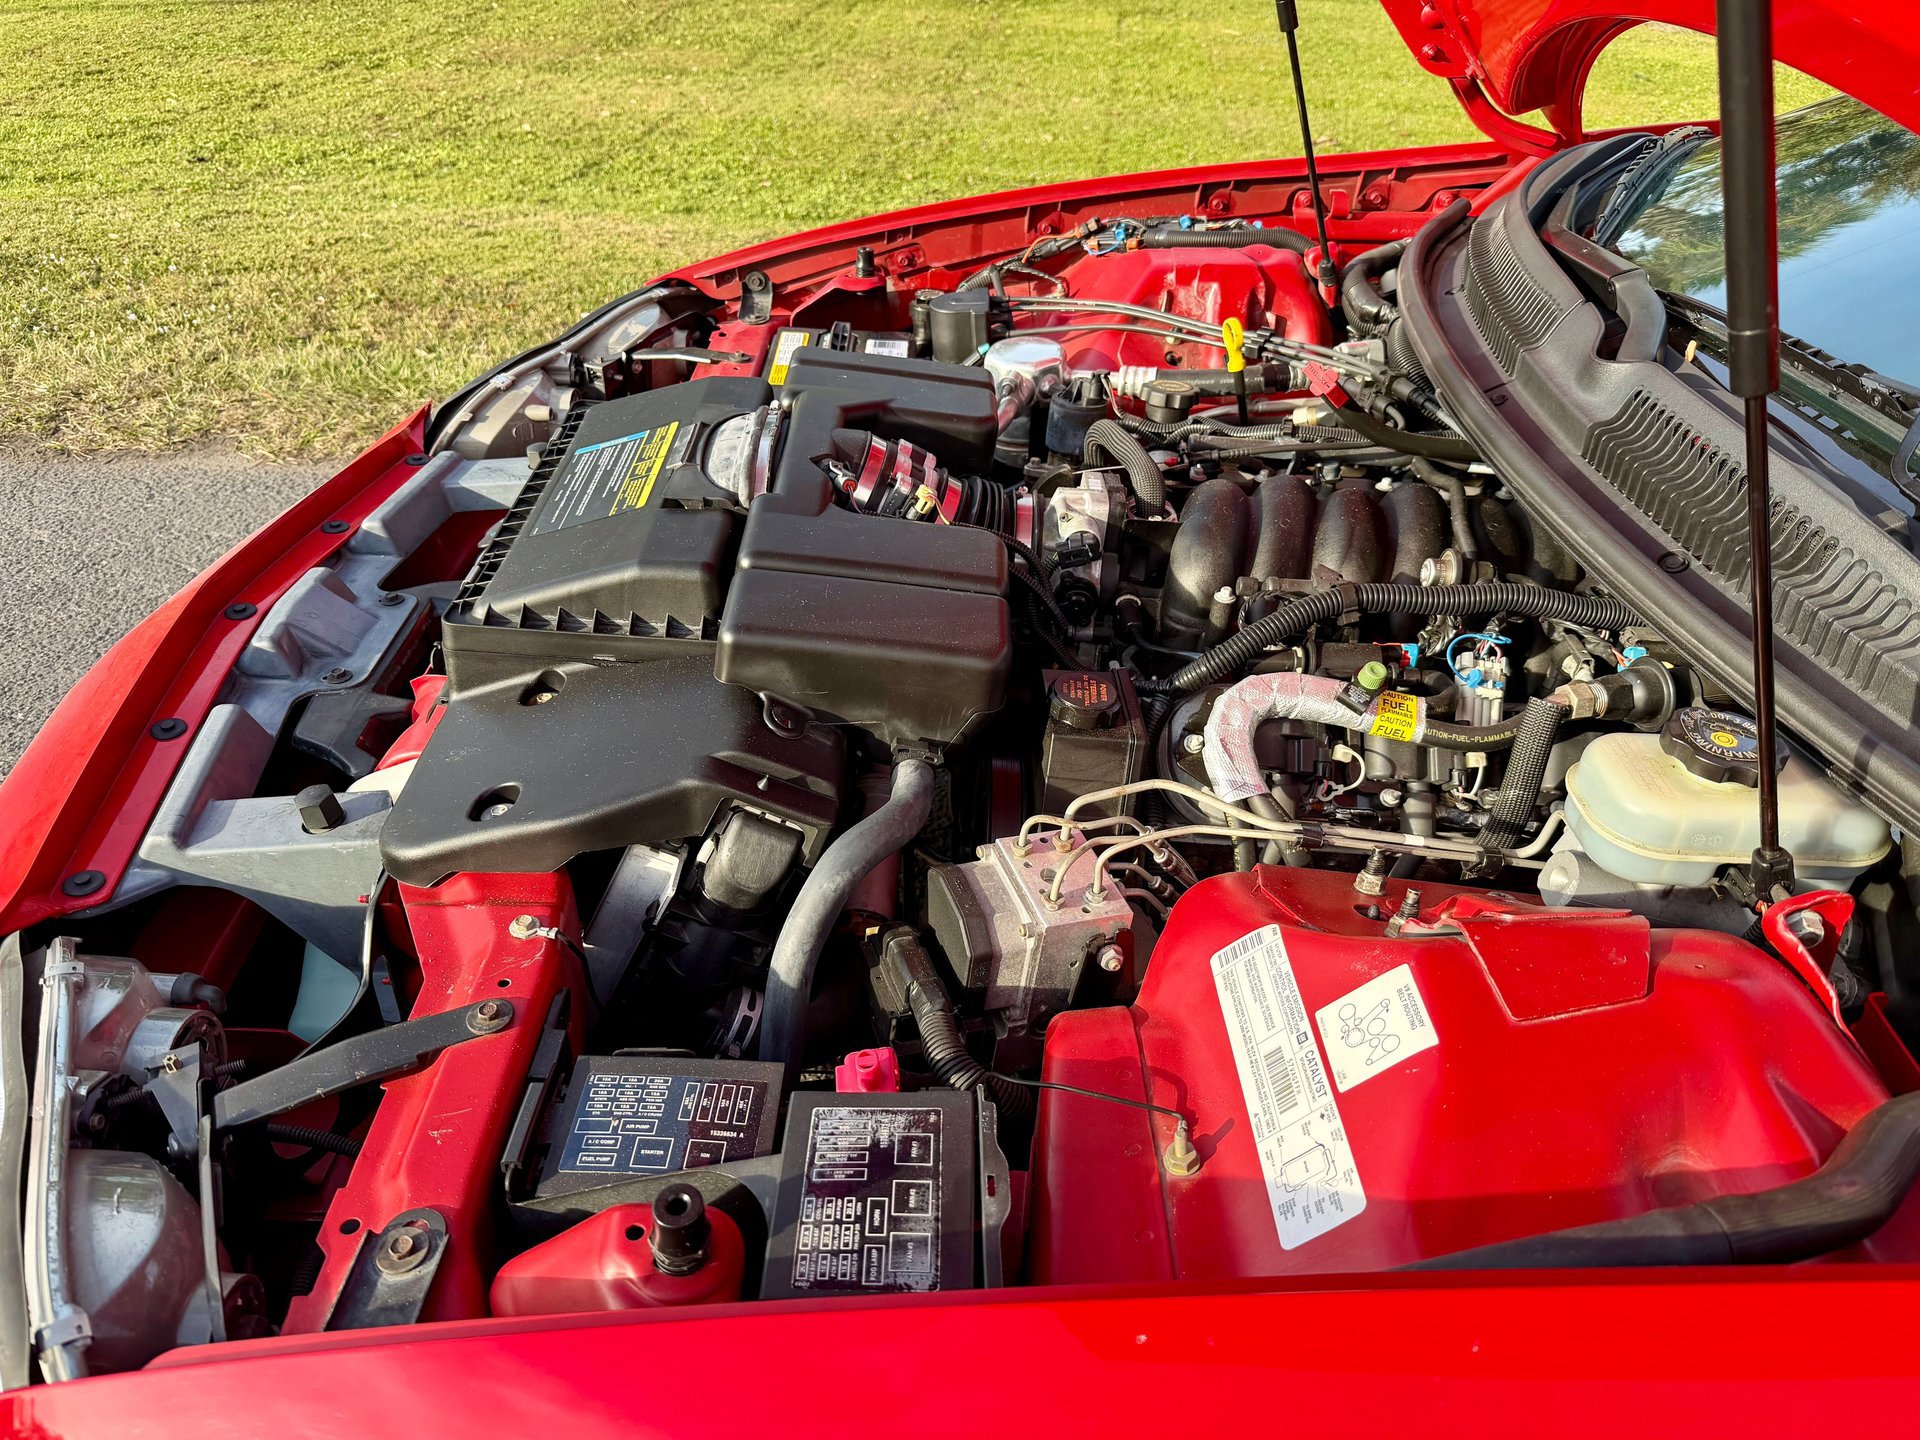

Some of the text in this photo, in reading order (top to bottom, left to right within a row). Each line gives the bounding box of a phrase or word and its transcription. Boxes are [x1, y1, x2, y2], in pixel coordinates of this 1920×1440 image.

[1381, 690, 1413, 703] CAUTION
[1381, 706, 1413, 719] FLAMMABLE
[1382, 698, 1412, 713] FUEL
[1380, 715, 1413, 728] CAUTION
[1710, 712, 1731, 722] DOT
[1376, 725, 1406, 739] FUEL
[1275, 966, 1301, 1034] CONTROL INFORMATION
[1283, 970, 1304, 1022] VEHICLE EMISSION
[1396, 987, 1417, 1031] BELT ROUTING
[1406, 990, 1425, 1029] ACCESSORY
[1304, 1048, 1327, 1100] CATALYST
[1265, 1101, 1277, 1131] CALIFORNIA
[1328, 1102, 1336, 1120] FRONT
[869, 1266, 877, 1280] FOG
